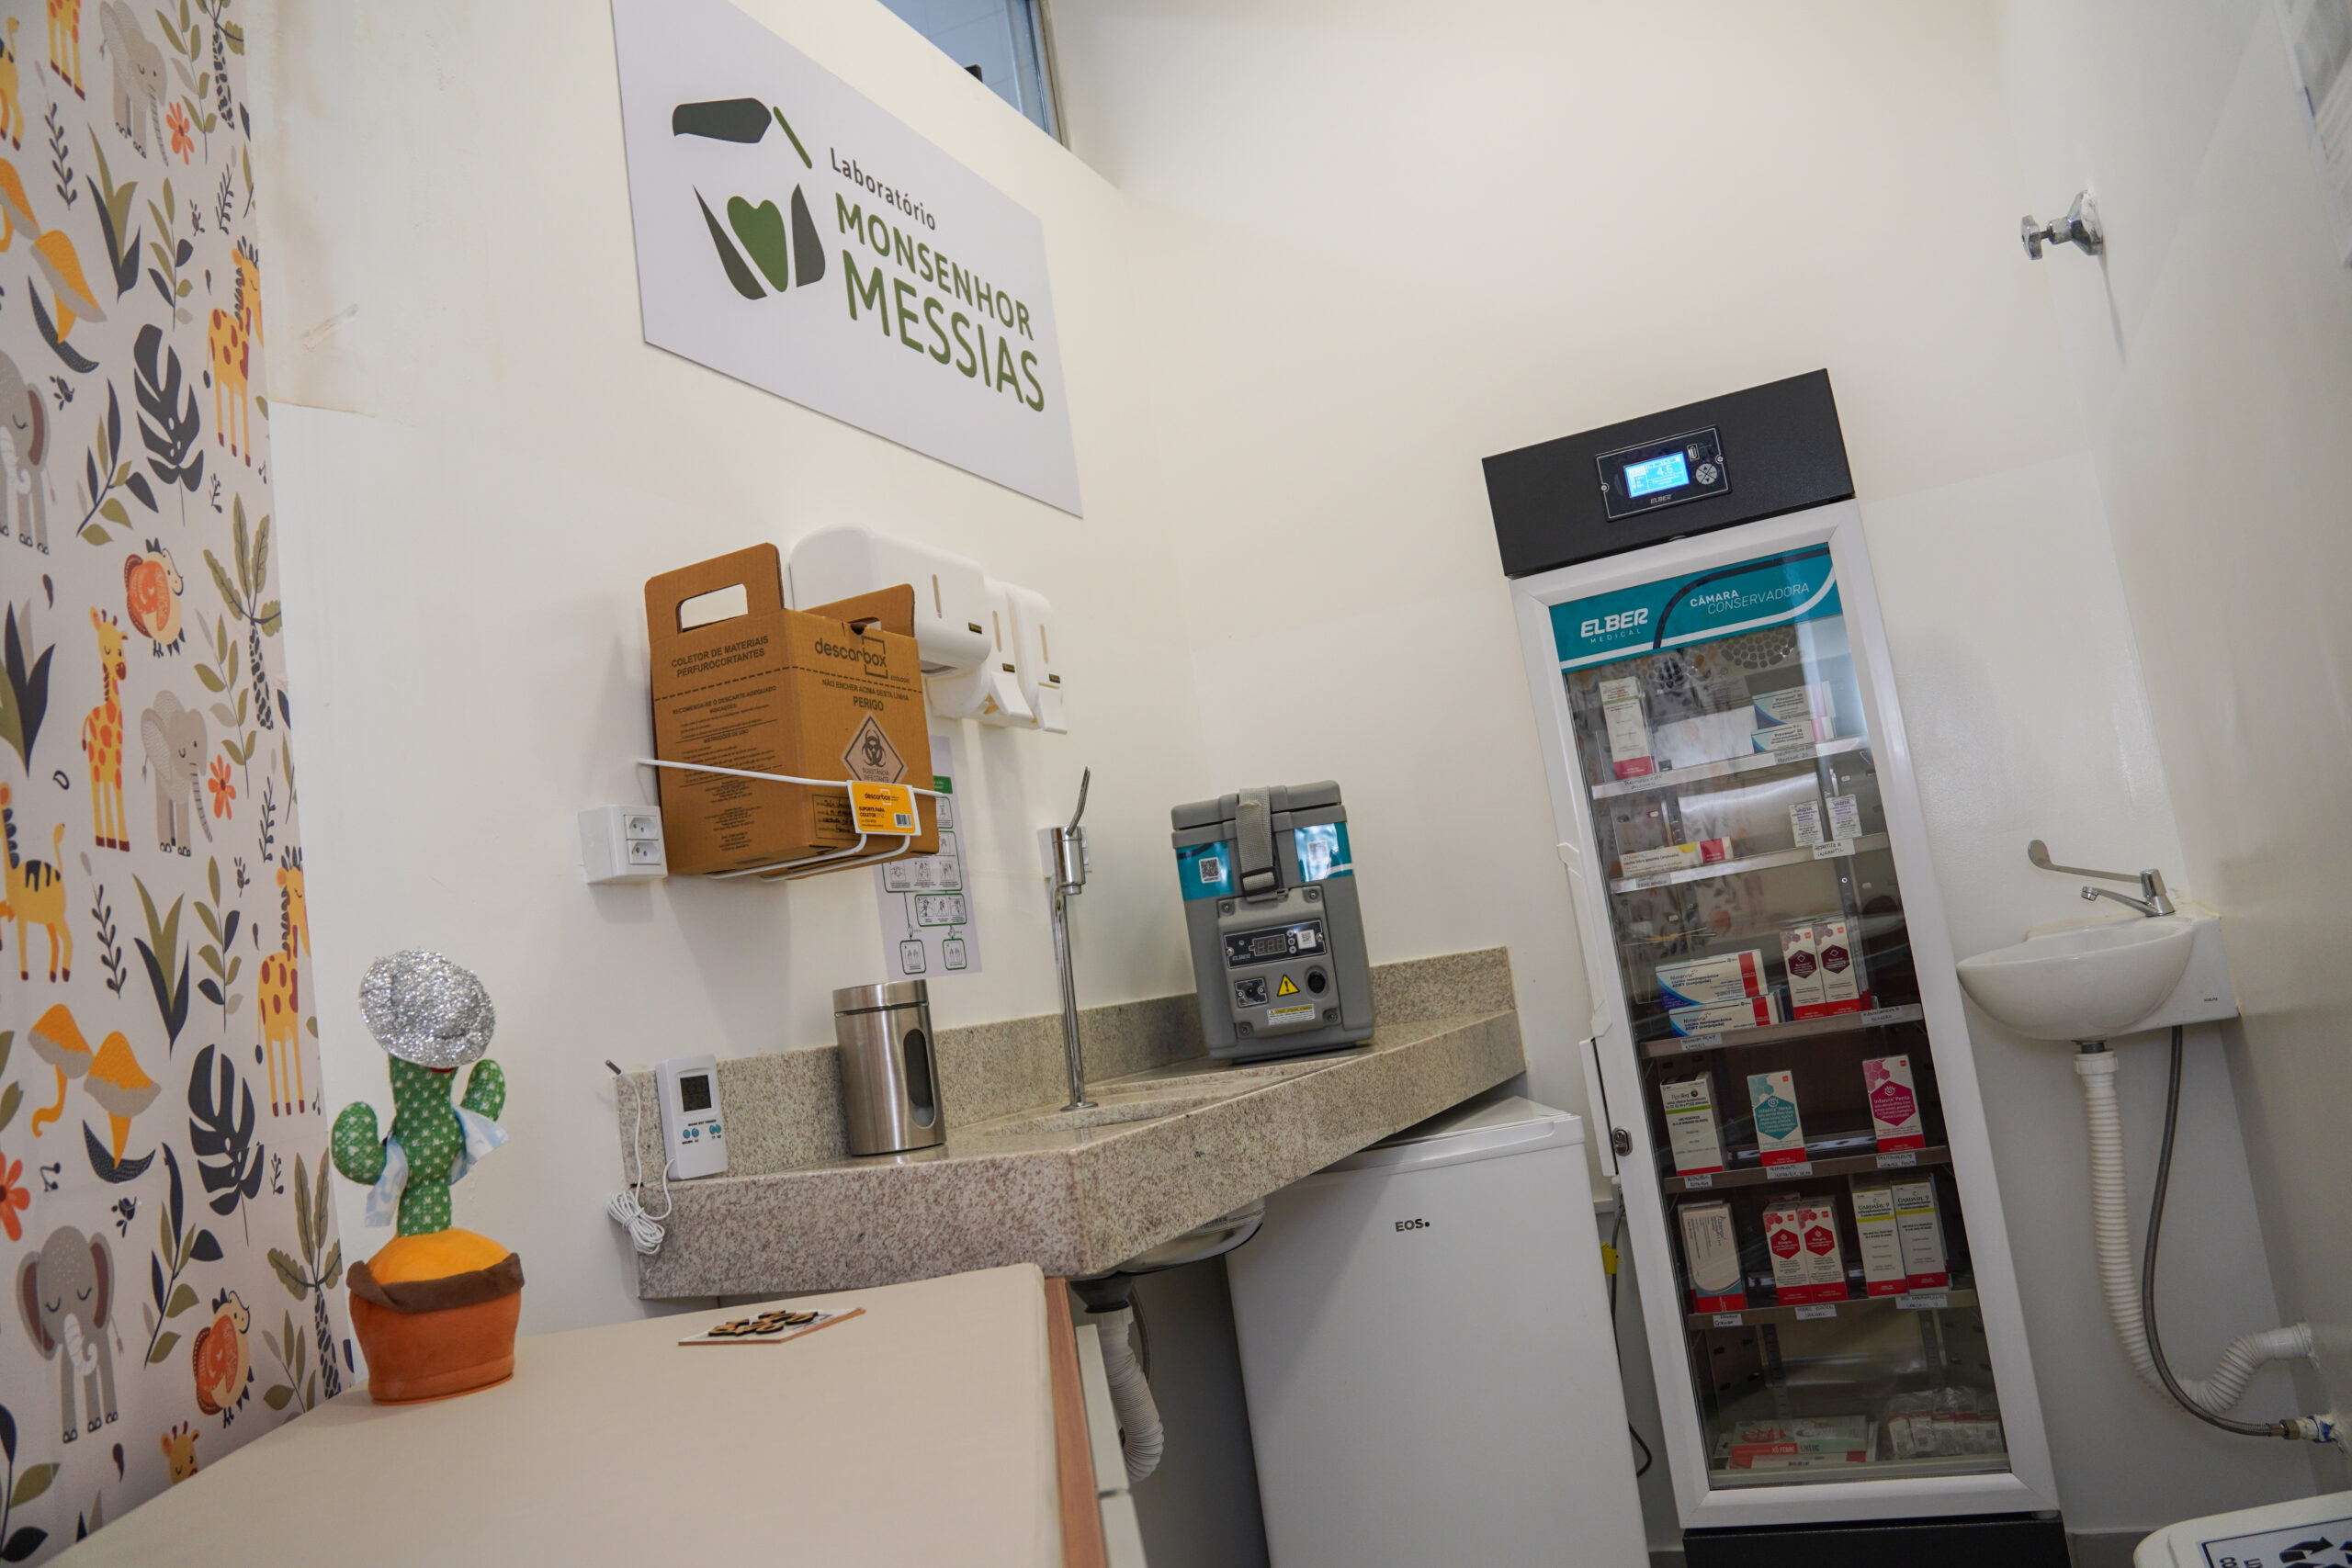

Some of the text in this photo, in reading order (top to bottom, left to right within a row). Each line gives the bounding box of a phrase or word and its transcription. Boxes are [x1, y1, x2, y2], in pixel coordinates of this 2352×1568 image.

[830, 147, 936, 231] Laboratório
[835, 192, 1034, 341] MONSENHOR
[842, 249, 1044, 412] MESSIAS
[1690, 589, 1739, 608] CÂMARA
[1707, 582, 1810, 615] CONSERVADORA
[1580, 607, 1649, 638] ELBER
[1590, 628, 1642, 644] MEDICAL
[672, 636, 769, 668] COLETOR DE MATERIAIS
[676, 648, 765, 677] PERFUROCORTANTES
[815, 637, 887, 668] descarbox
[853, 695, 884, 711] PERIGO
